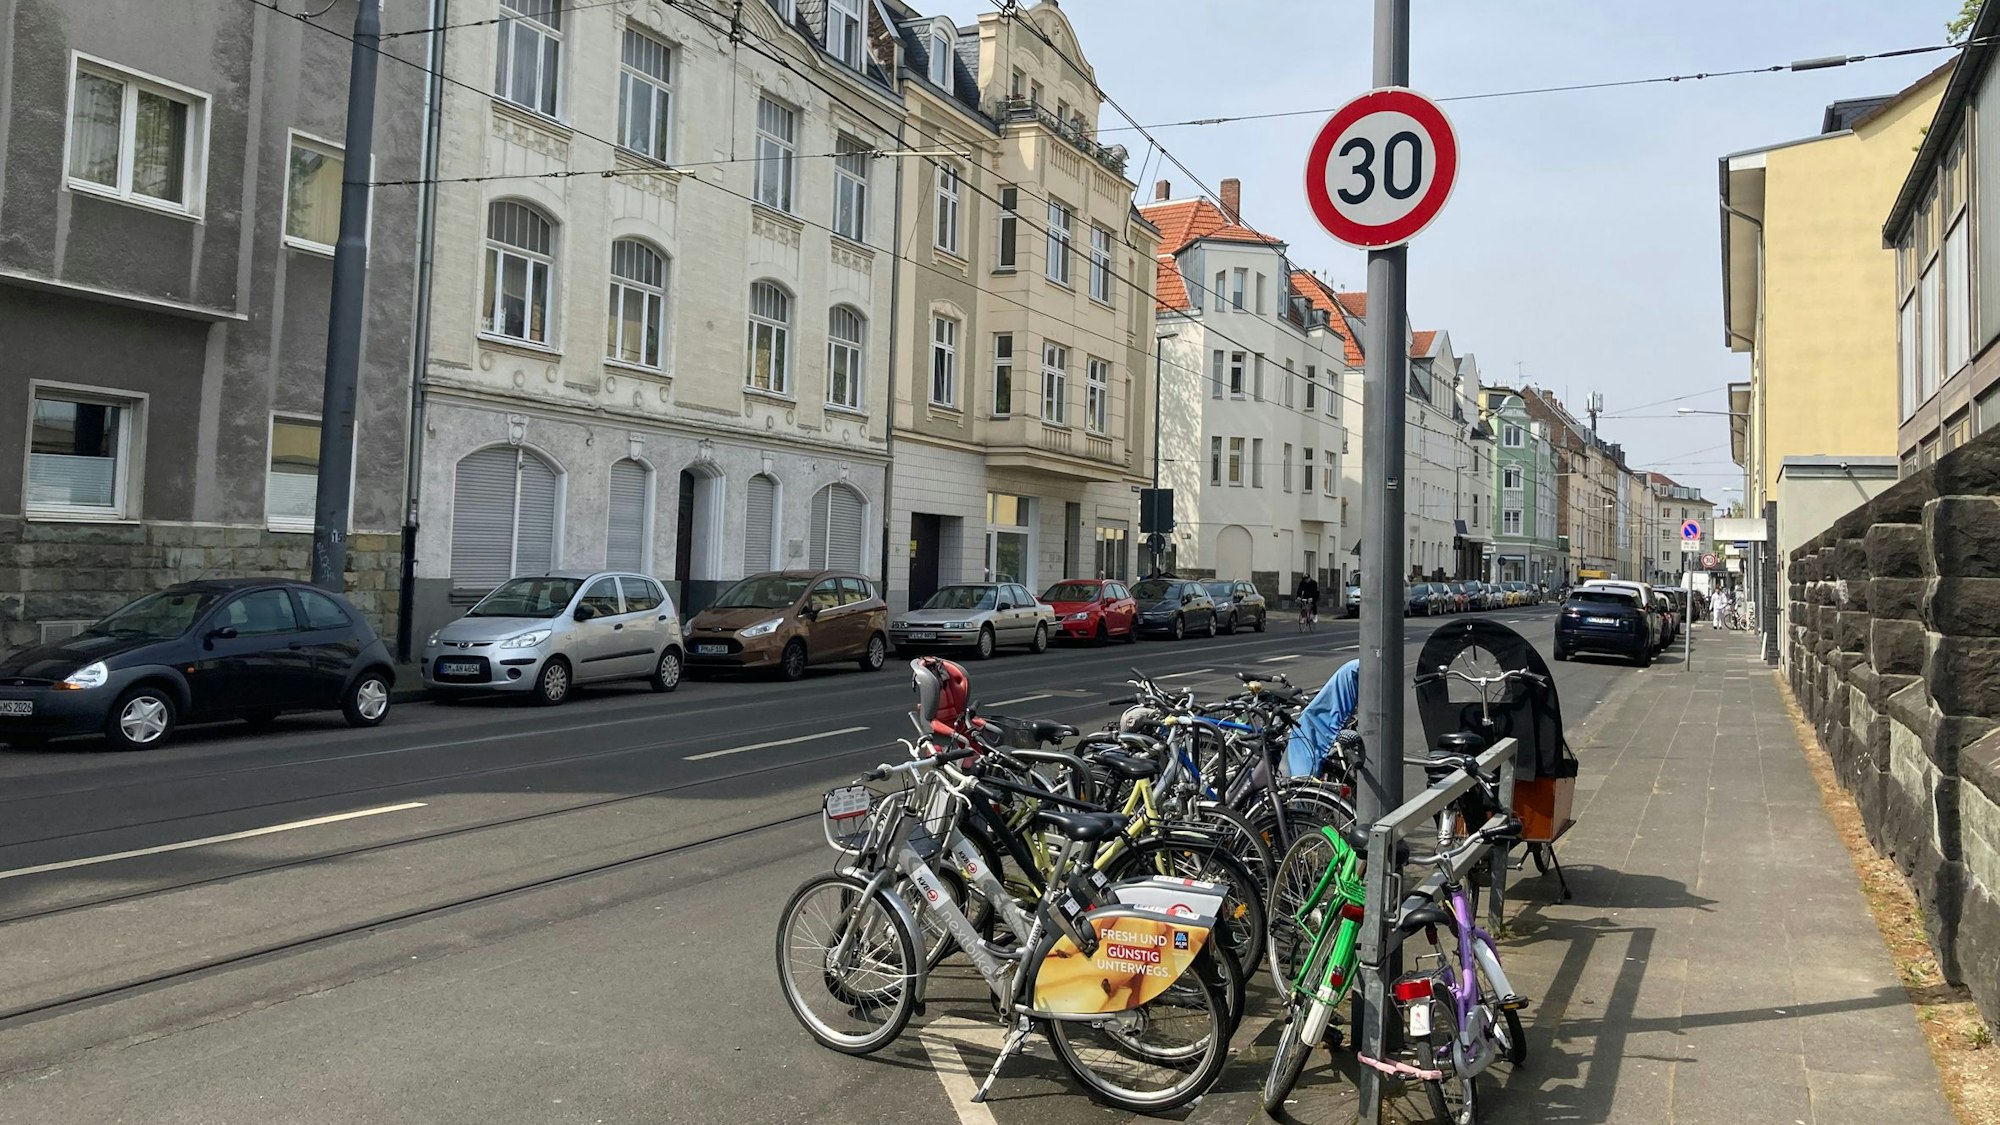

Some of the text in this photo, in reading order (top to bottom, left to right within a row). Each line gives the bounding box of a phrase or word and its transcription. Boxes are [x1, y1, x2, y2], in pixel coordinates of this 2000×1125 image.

[1338, 130, 1422, 205] 30
[917, 876, 930, 891] KVB
[941, 910, 992, 977] nextbike
[1100, 928, 1168, 947] FRESH UND
[1107, 944, 1160, 963] GÜNSTIG
[1096, 958, 1172, 978] UNTERWEGS.
